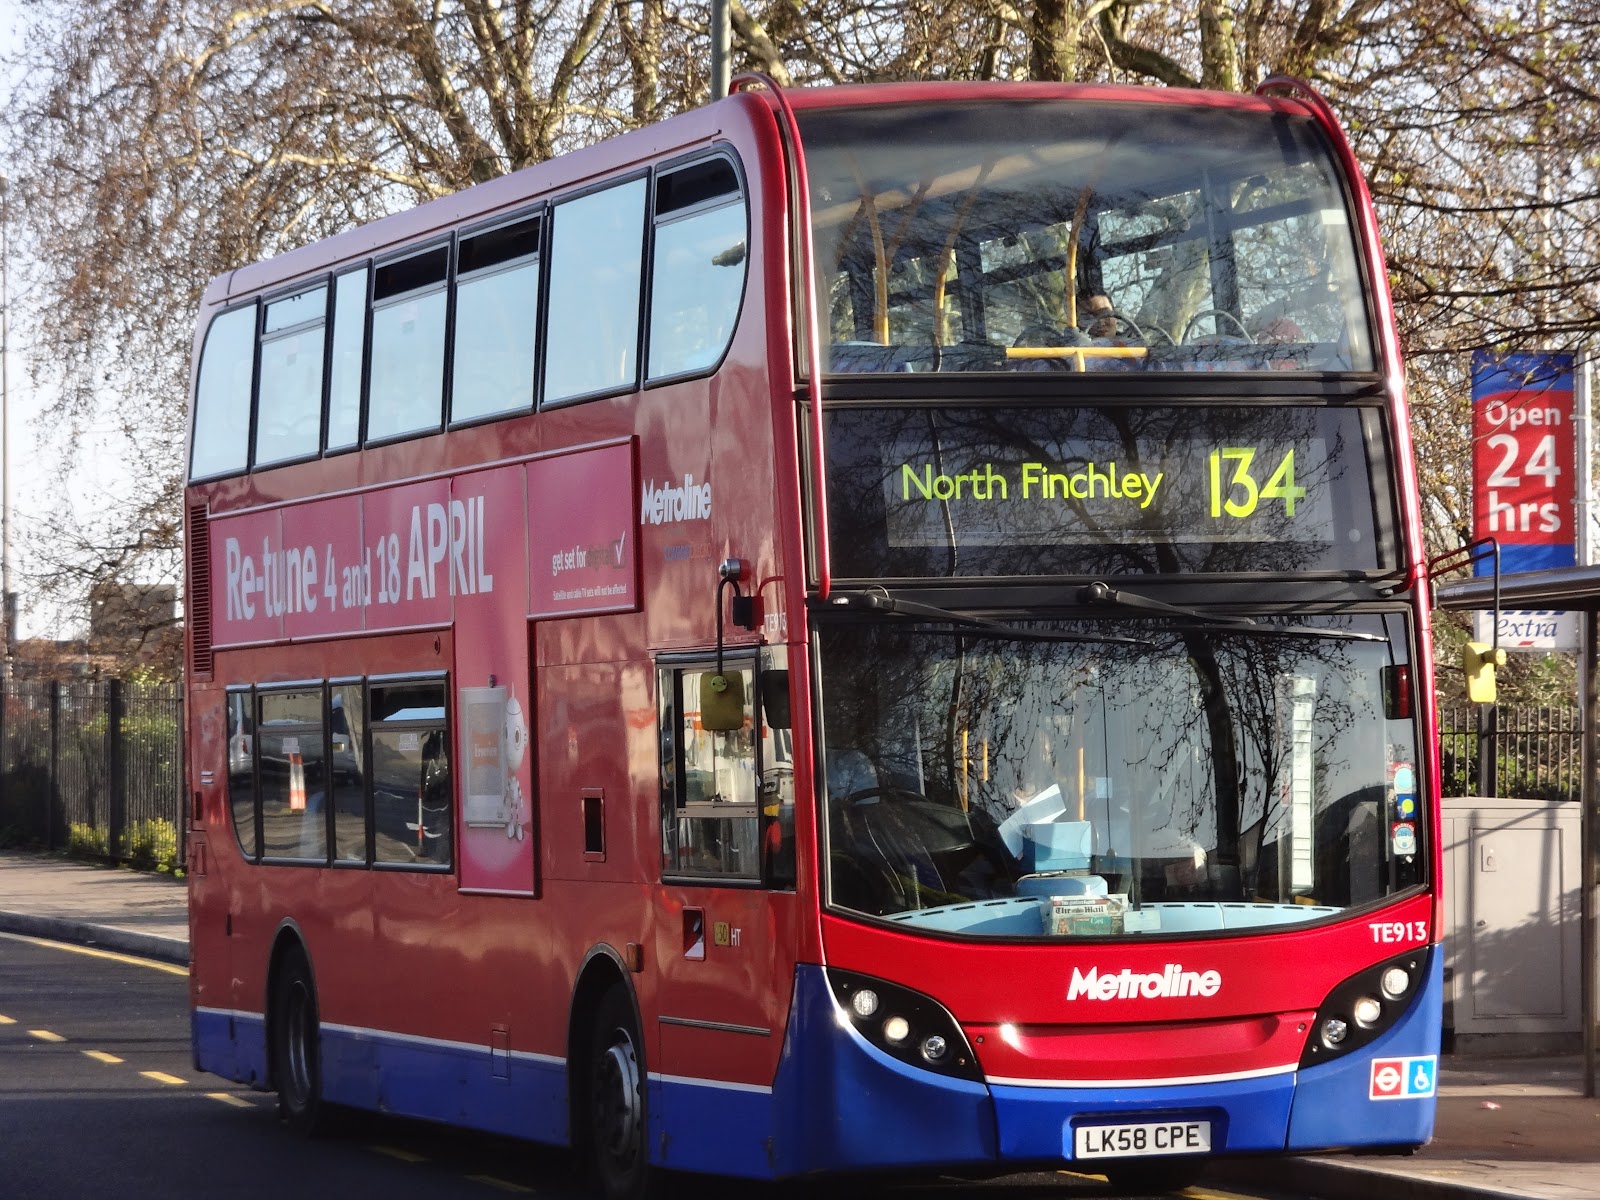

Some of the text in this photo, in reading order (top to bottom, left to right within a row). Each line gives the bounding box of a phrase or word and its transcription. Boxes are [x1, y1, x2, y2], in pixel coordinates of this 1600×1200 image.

[1485, 400, 1561, 430] Open
[1486, 434, 1561, 488] 24
[641, 473, 712, 525] Metroline
[901, 462, 1164, 509] North Finchley
[1209, 447, 1307, 518] 134
[1488, 490, 1561, 533] hrs
[225, 495, 494, 621] Re-tune 4 and 18 APRIL
[552, 549, 564, 577] get
[564, 548, 576, 570] set
[576, 545, 587, 568] for
[1496, 618, 1559, 638] extra
[1084, 906, 1104, 914] Mail
[1369, 921, 1428, 943] TE913
[1066, 963, 1222, 1002] Metroline
[1086, 1124, 1201, 1154] LK58 CPE
